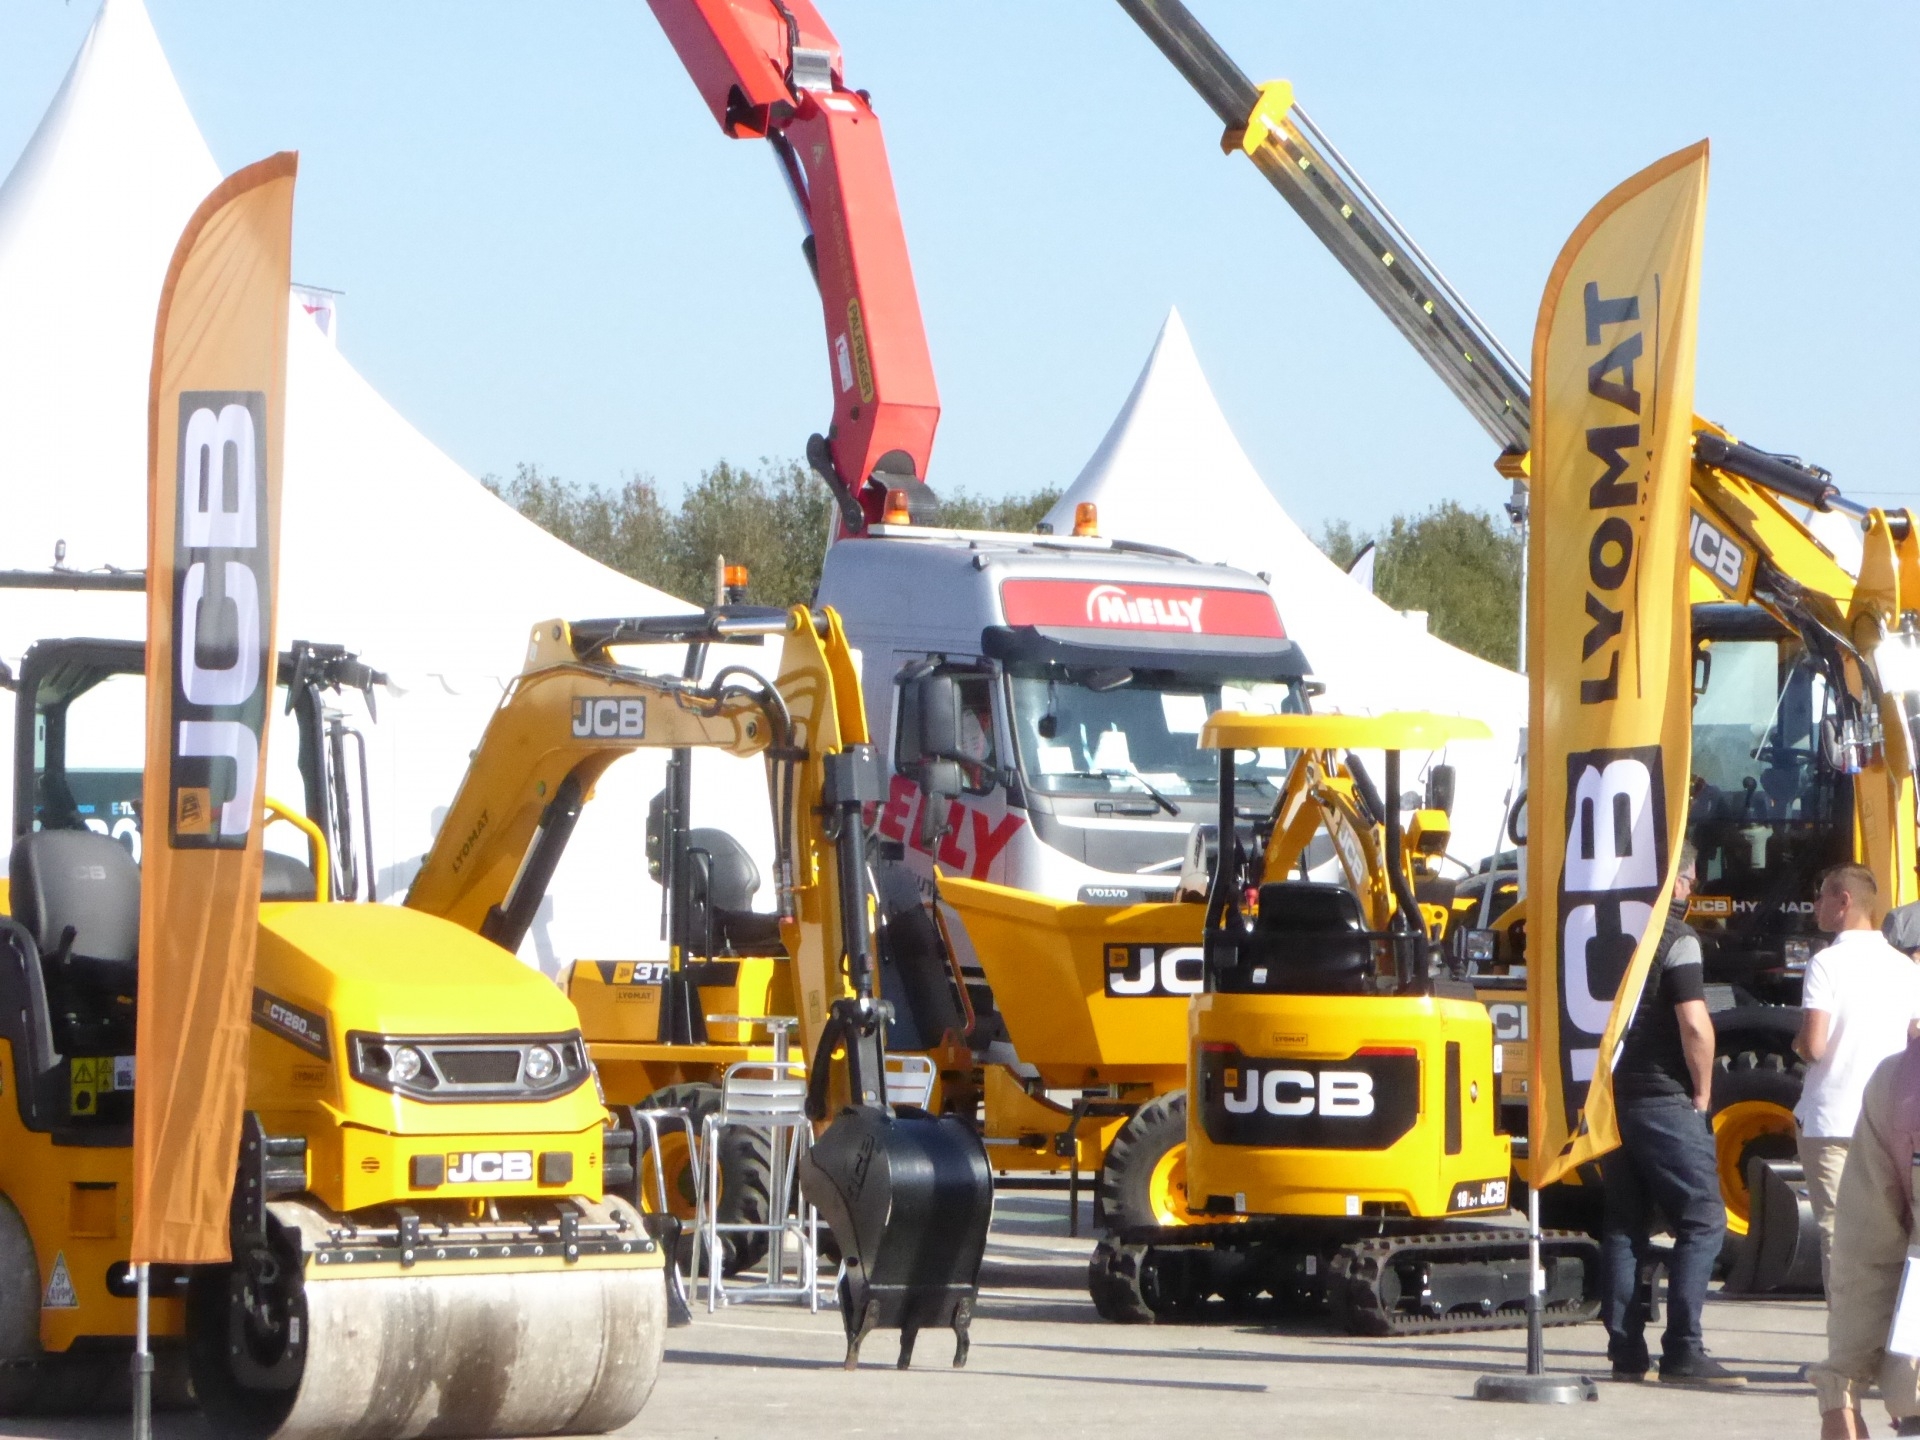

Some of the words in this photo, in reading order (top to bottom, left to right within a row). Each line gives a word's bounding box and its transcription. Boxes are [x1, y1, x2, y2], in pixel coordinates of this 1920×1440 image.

[848, 302, 872, 398] PALFINGER
[1580, 281, 1643, 705] LYOMAT
[178, 403, 261, 836] JCB
[572, 699, 644, 737] JCB
[453, 810, 490, 873] LYOMAT
[1086, 887, 1129, 898] VOLVO
[1690, 900, 1729, 912] JCB
[1109, 947, 1205, 994] JC
[1223, 1069, 1375, 1117] JCB
[447, 1151, 532, 1182] JCB
[1480, 1181, 1506, 1205] JCB
